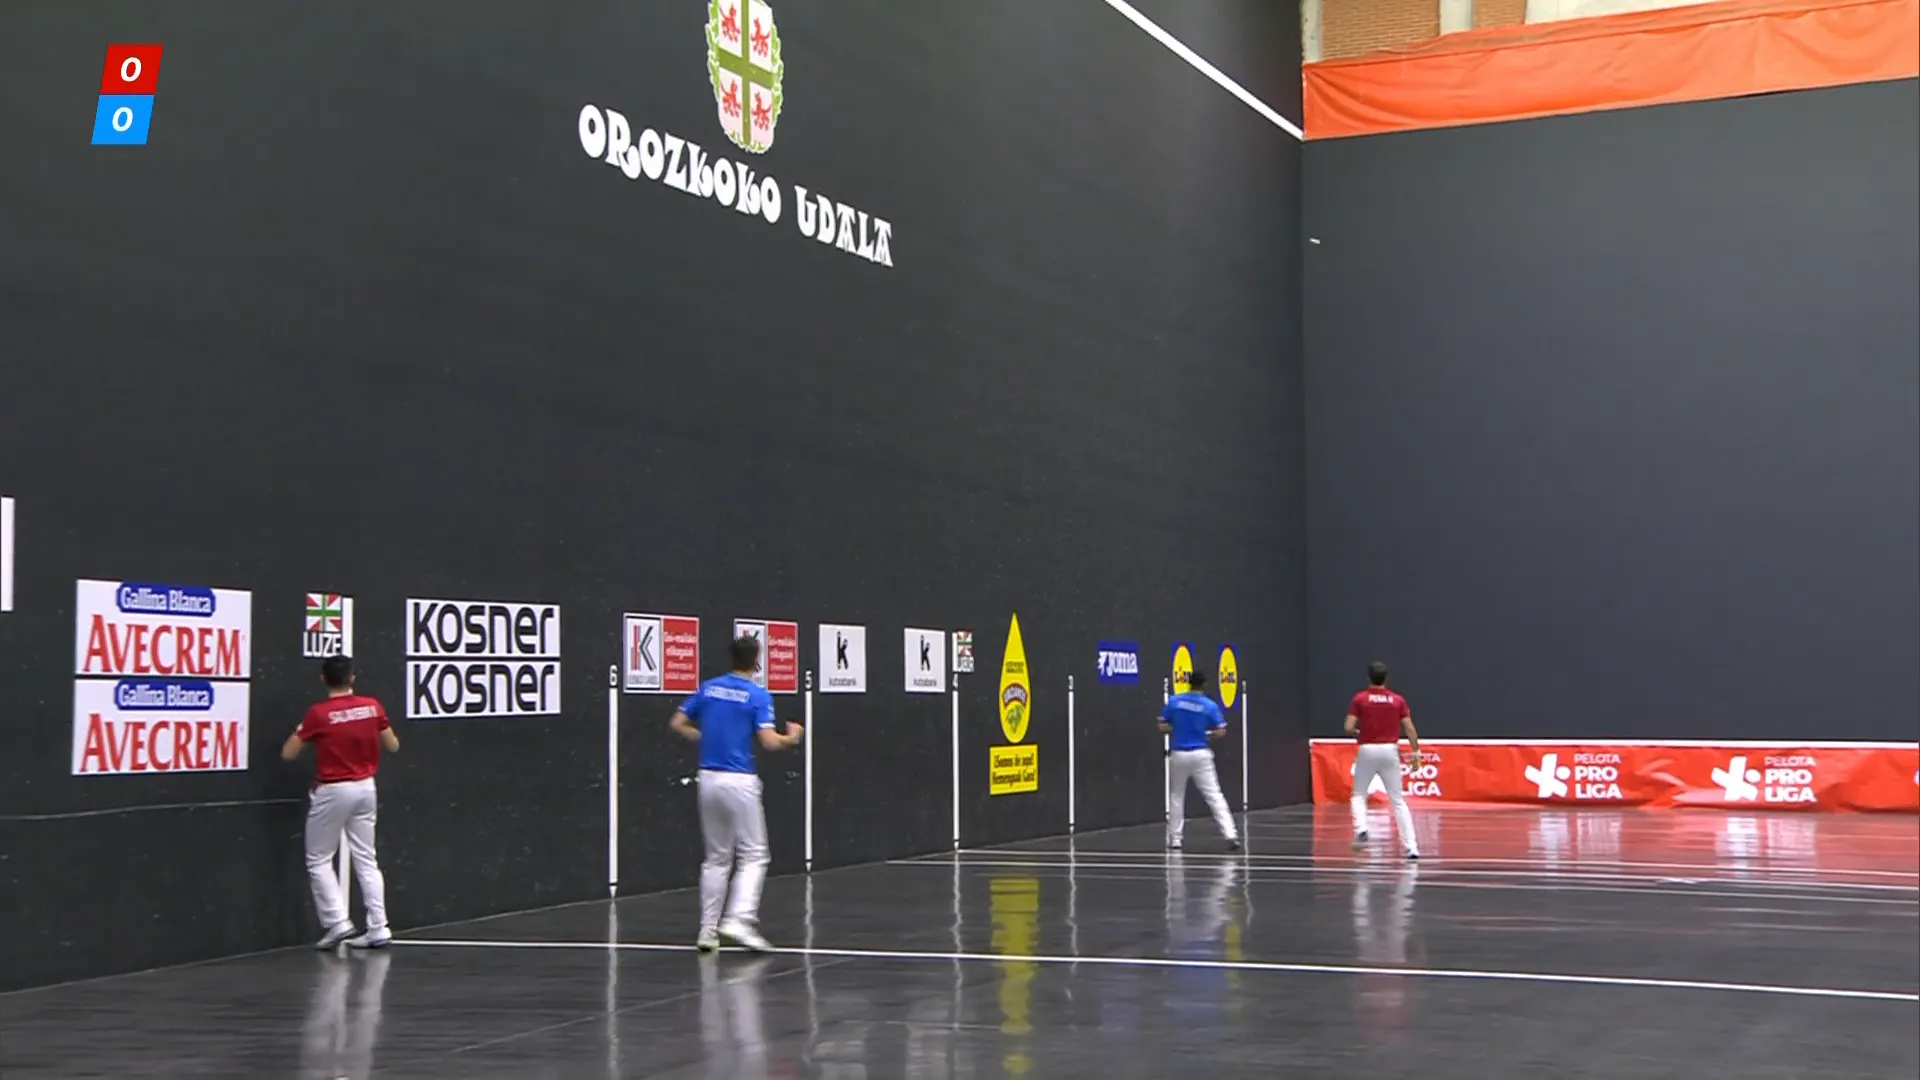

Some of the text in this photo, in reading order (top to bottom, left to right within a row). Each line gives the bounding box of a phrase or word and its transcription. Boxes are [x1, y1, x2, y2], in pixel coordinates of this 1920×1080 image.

[578, 103, 894, 268] OROZKOKO UDALA
[120, 586, 212, 613] Gallina Blanca
[82, 613, 242, 676] AVECREM
[302, 631, 342, 658] LUZE
[609, 664, 618, 686] 6
[804, 670, 813, 690] 5
[118, 683, 210, 707] Gallina Blanca
[79, 713, 239, 772] AVECREM
[1574, 753, 1621, 764] PELOTA
[1764, 756, 1816, 767] PELOTA
[1574, 766, 1618, 781] PRO
[1765, 768, 1813, 785] PRO
[1575, 783, 1622, 798] LIGA
[1765, 786, 1818, 802] LIGA
